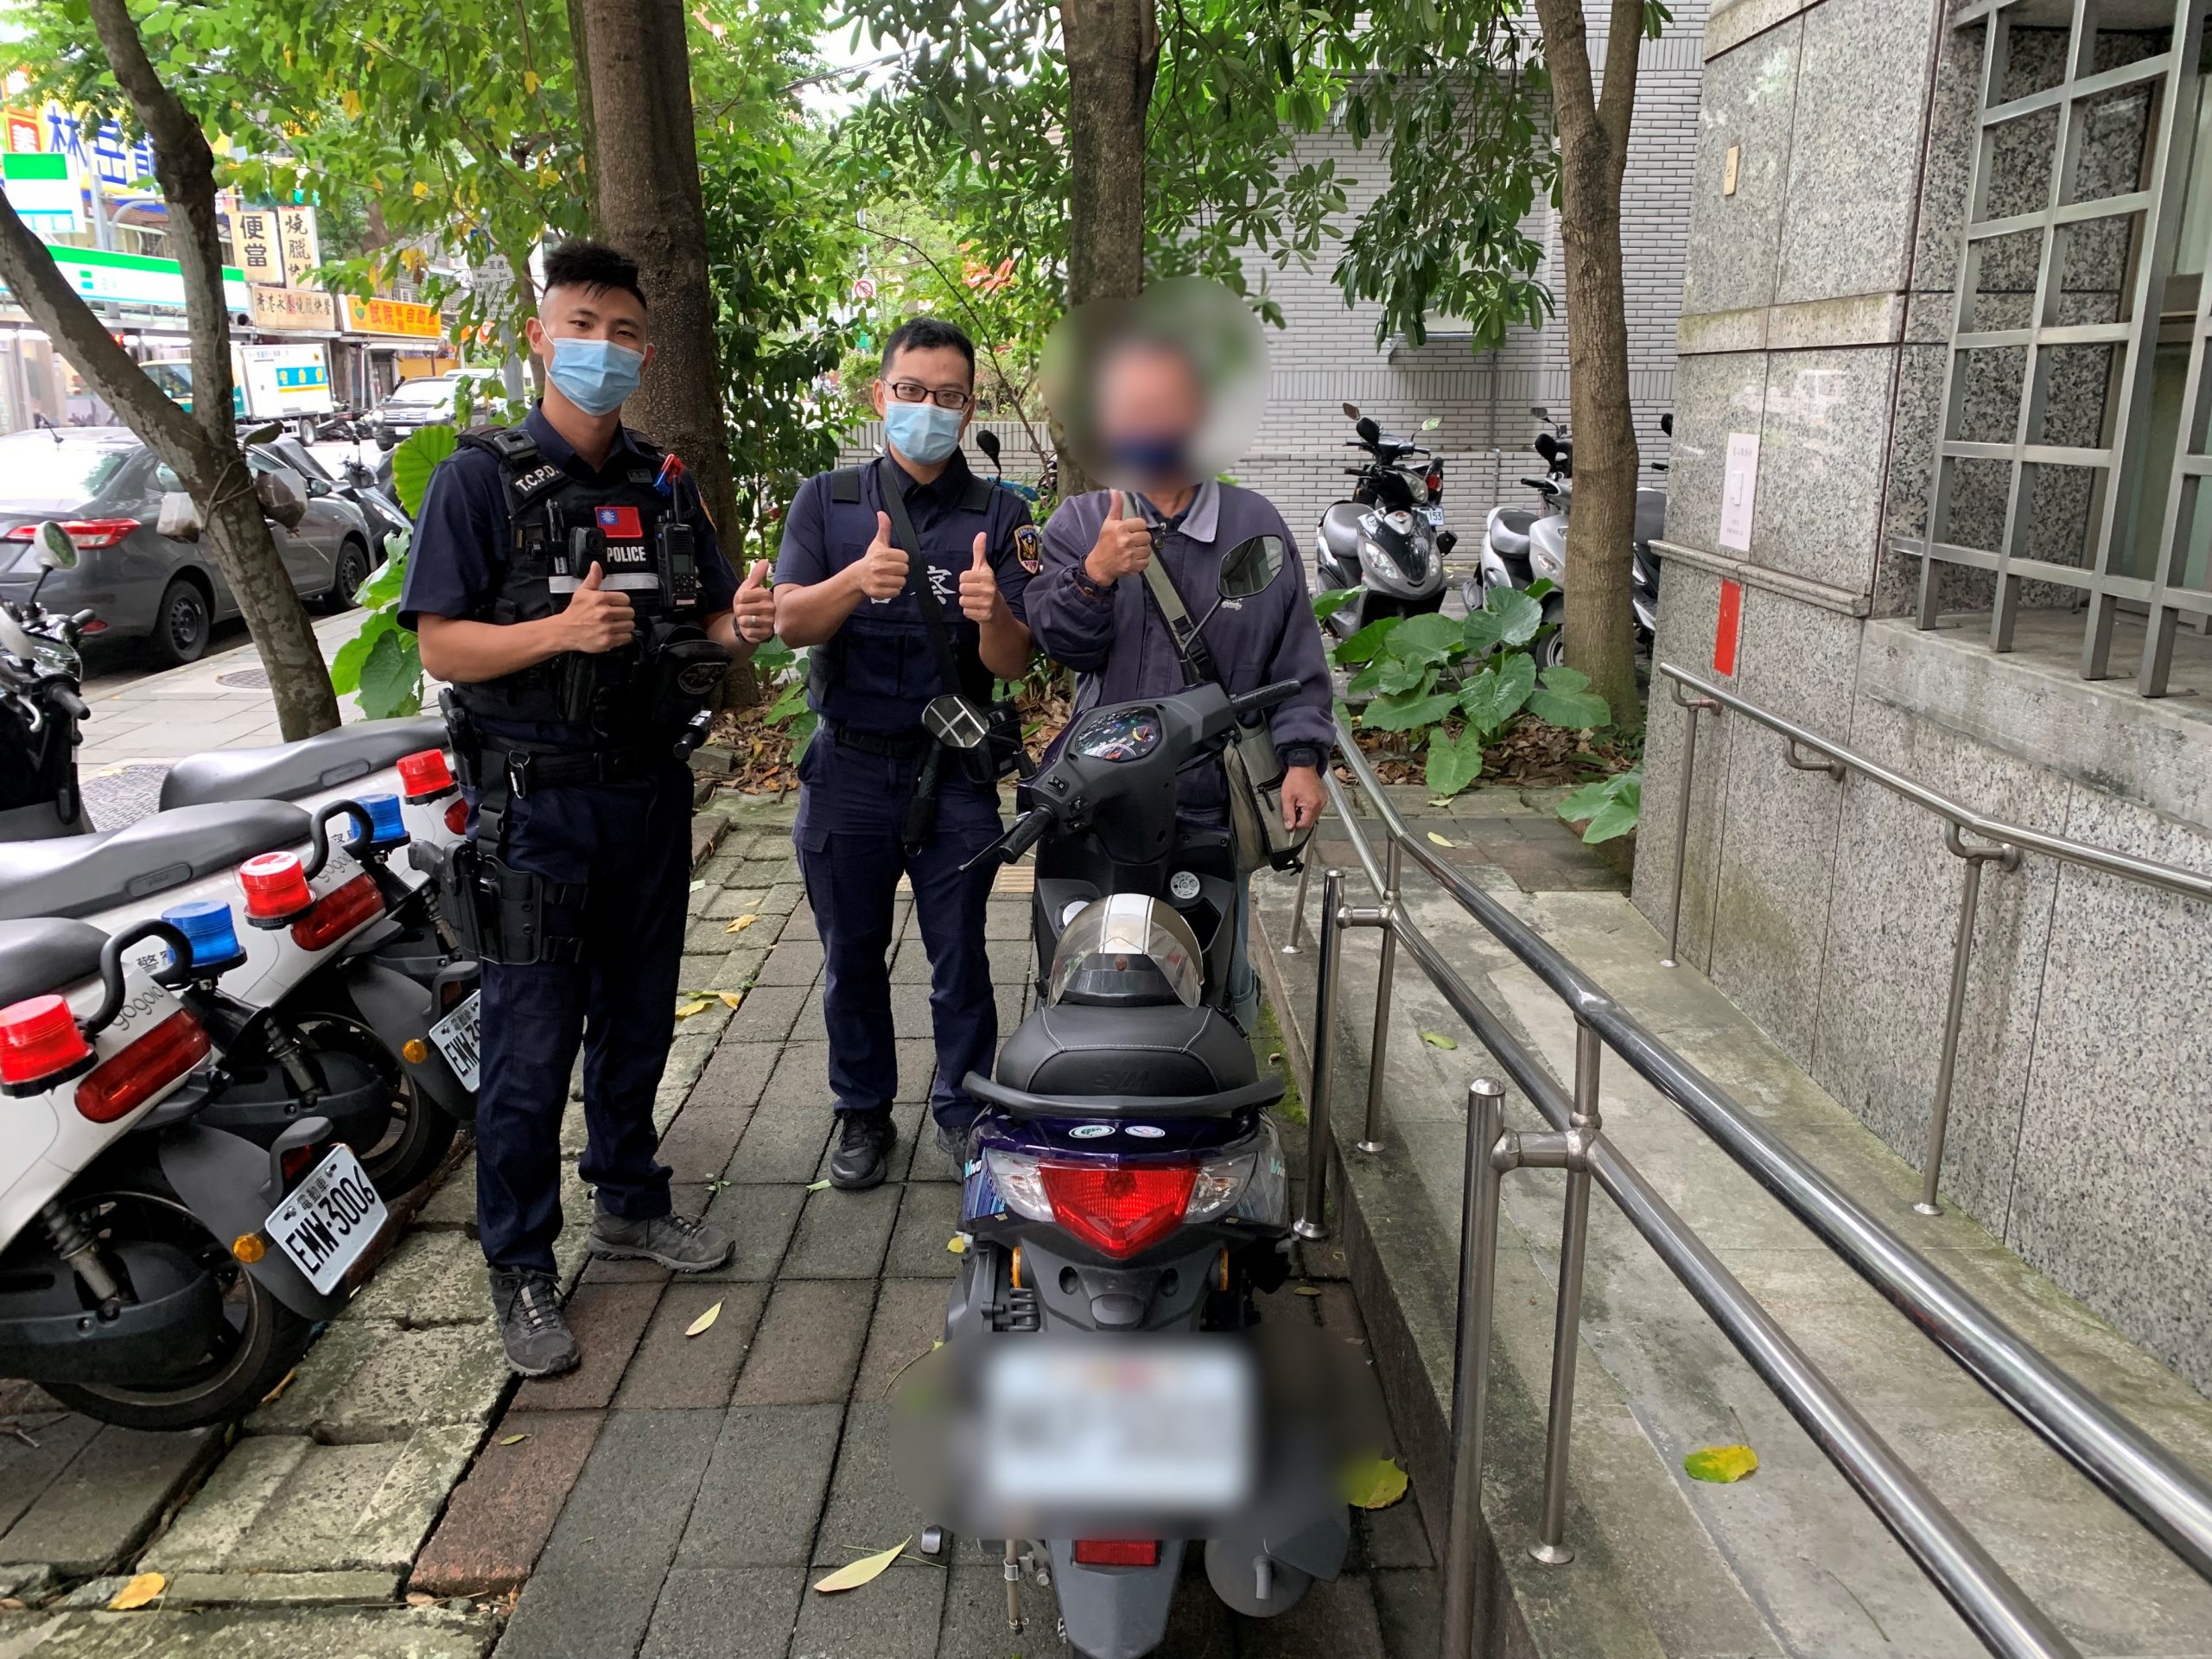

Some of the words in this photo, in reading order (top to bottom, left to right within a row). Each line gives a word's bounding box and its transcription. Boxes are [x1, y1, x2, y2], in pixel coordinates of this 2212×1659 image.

[240, 215, 267, 267] 便當
[515, 465, 561, 492] T.C.P.D.
[607, 546, 647, 563] POLICE
[296, 1175, 329, 1211] 電動車
